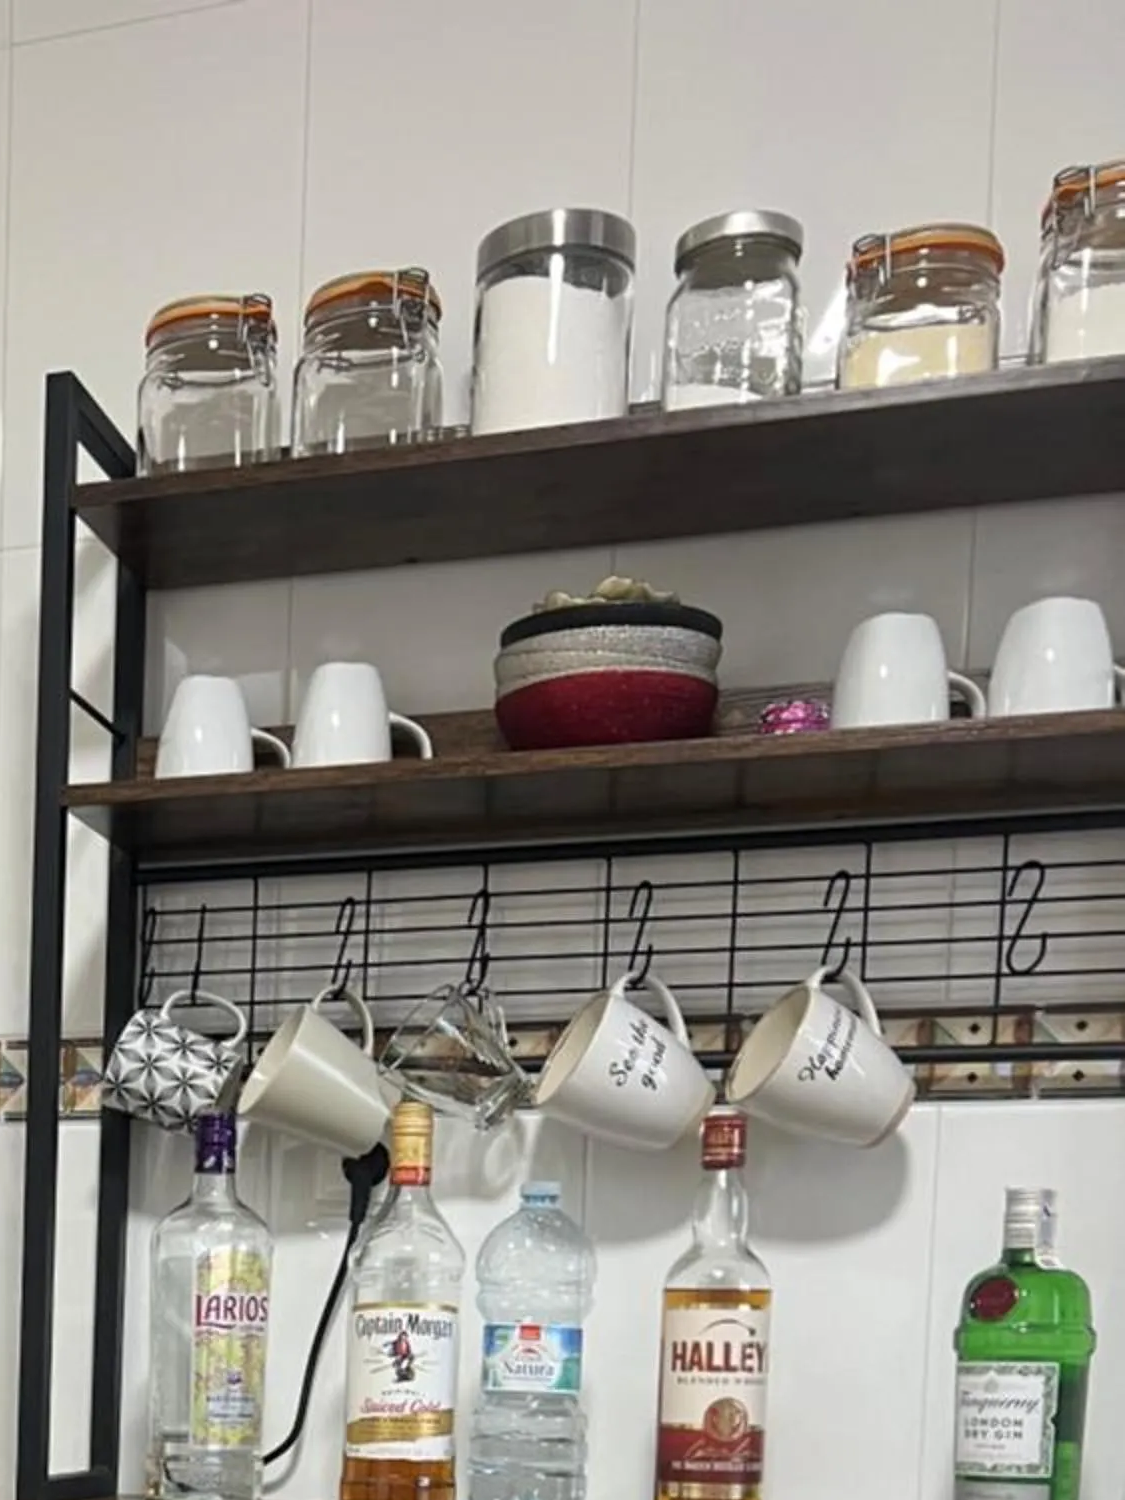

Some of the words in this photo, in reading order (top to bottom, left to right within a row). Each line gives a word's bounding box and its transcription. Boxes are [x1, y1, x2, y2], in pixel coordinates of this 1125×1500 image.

[195, 1293, 269, 1328] LARIOS
[355, 1312, 405, 1341] Captain
[670, 1340, 769, 1373] HALLEY
[963, 1416, 1024, 1429] LONDON
[993, 1428, 1024, 1440] GIN
